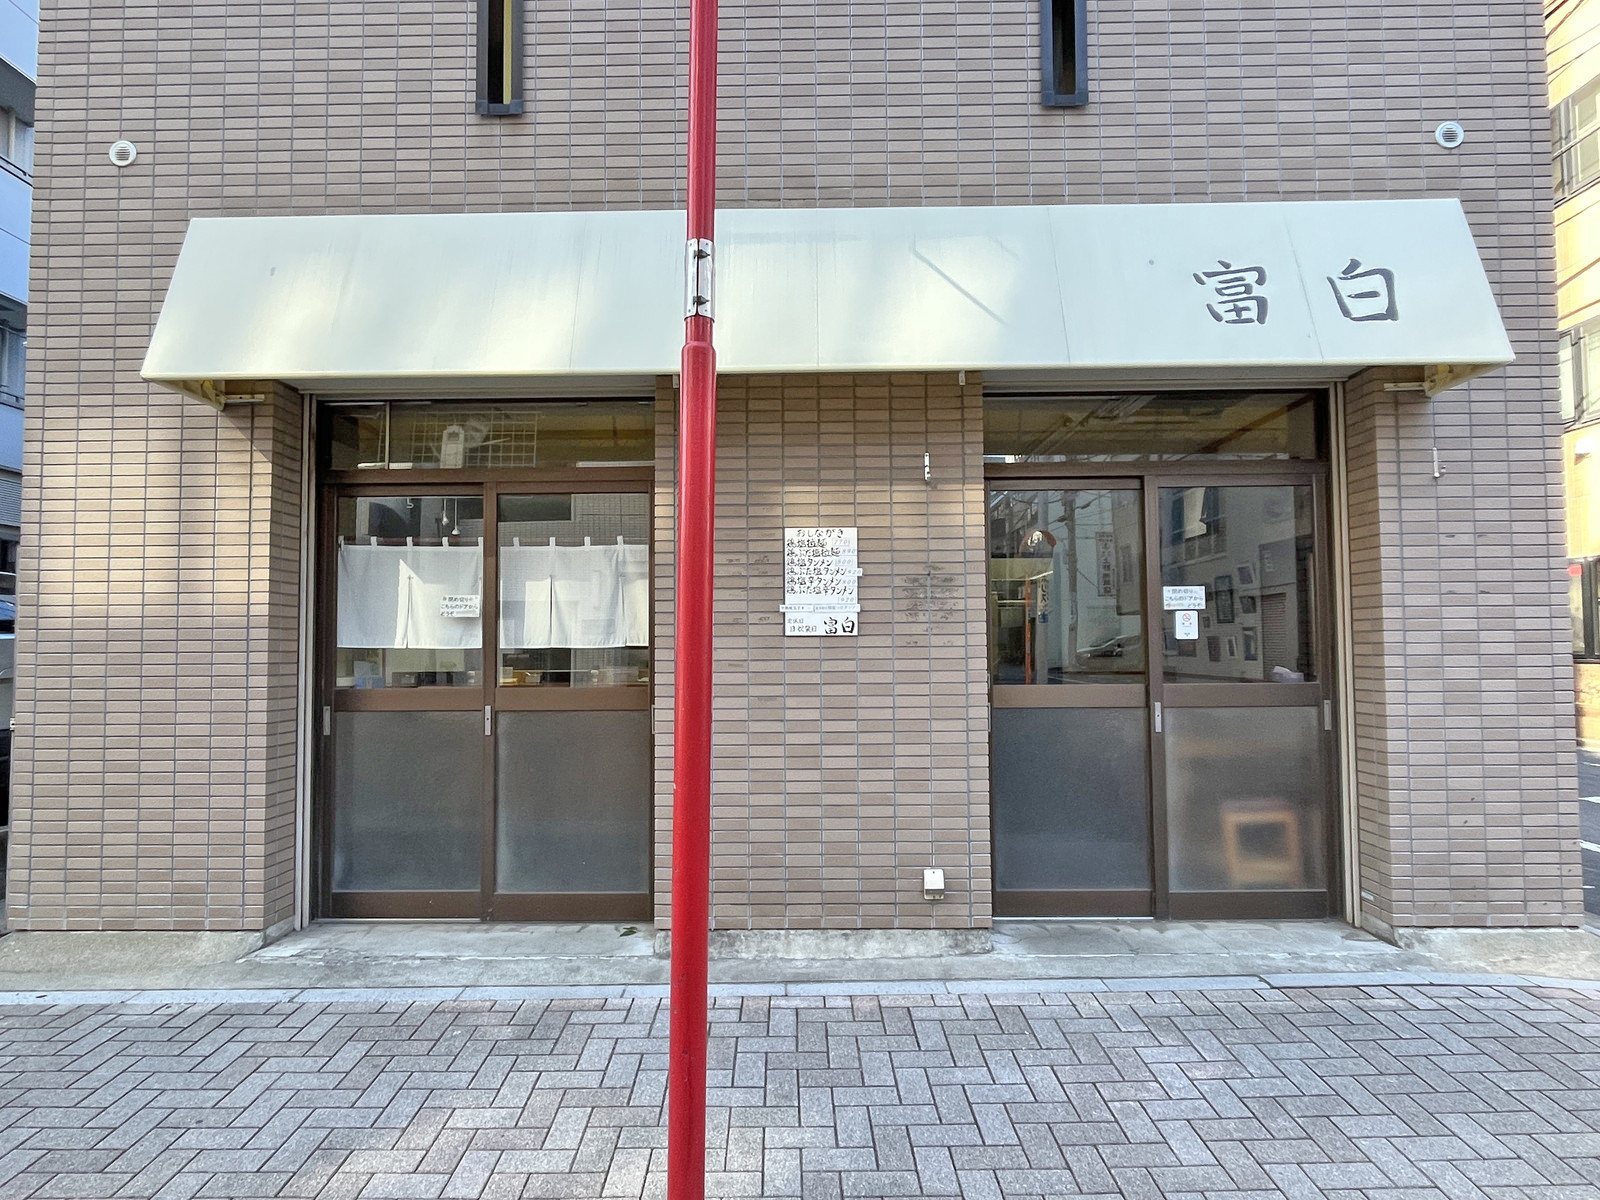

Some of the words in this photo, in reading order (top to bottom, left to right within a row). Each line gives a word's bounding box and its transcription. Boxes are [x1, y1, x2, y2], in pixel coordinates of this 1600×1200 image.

[1192, 258, 1399, 325] 富白
[796, 529, 844, 538] おしながき
[823, 616, 856, 635] 富白
